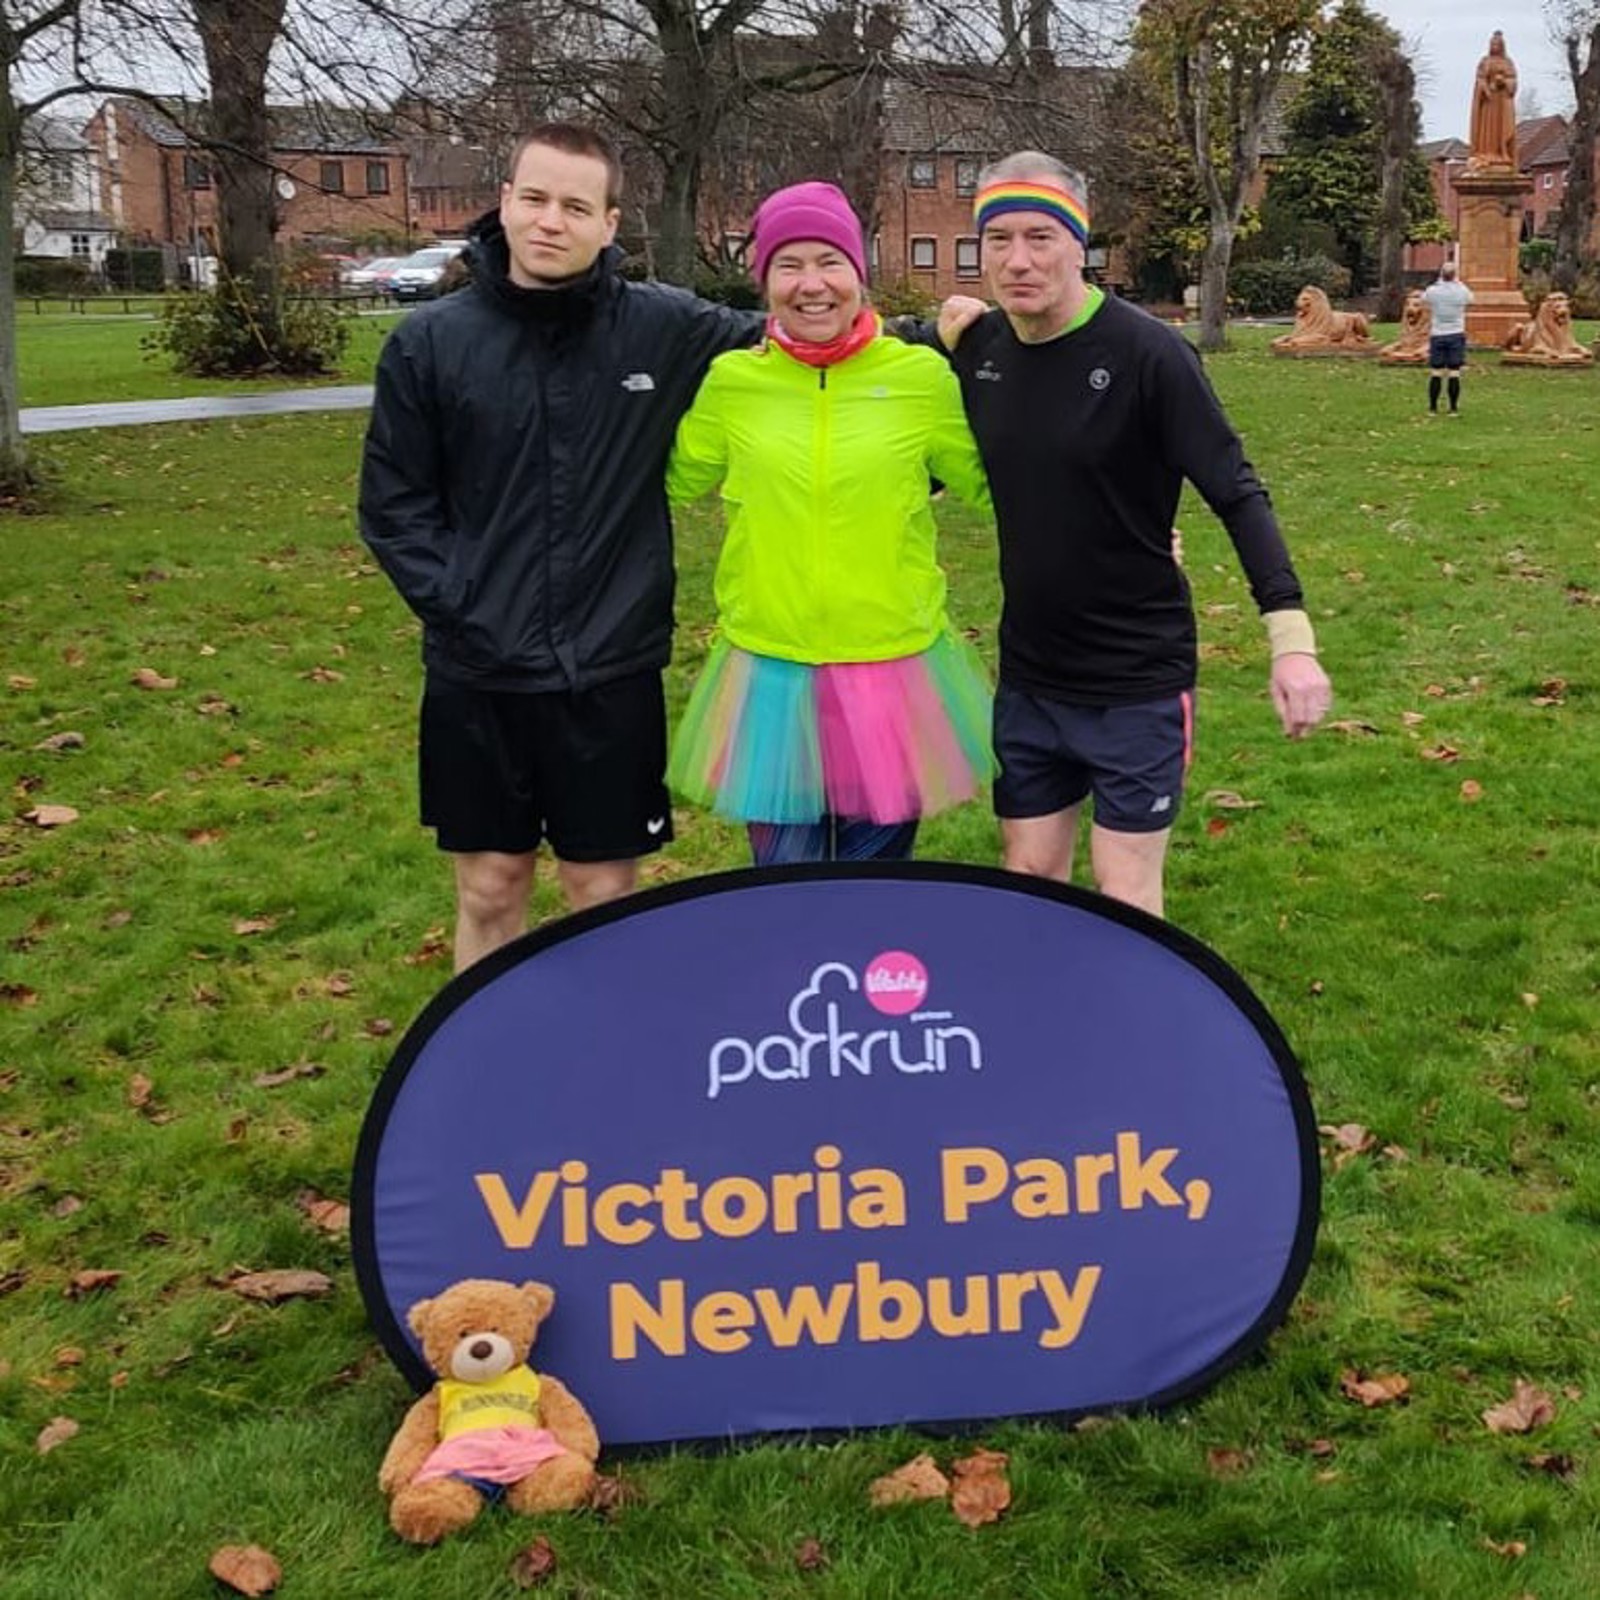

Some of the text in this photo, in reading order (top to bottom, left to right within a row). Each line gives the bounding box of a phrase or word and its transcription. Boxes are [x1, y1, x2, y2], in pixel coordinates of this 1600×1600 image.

[707, 1001, 982, 1099] parkrun
[474, 1130, 1212, 1250] Victoria Park,
[608, 1261, 1102, 1361] Newbury
